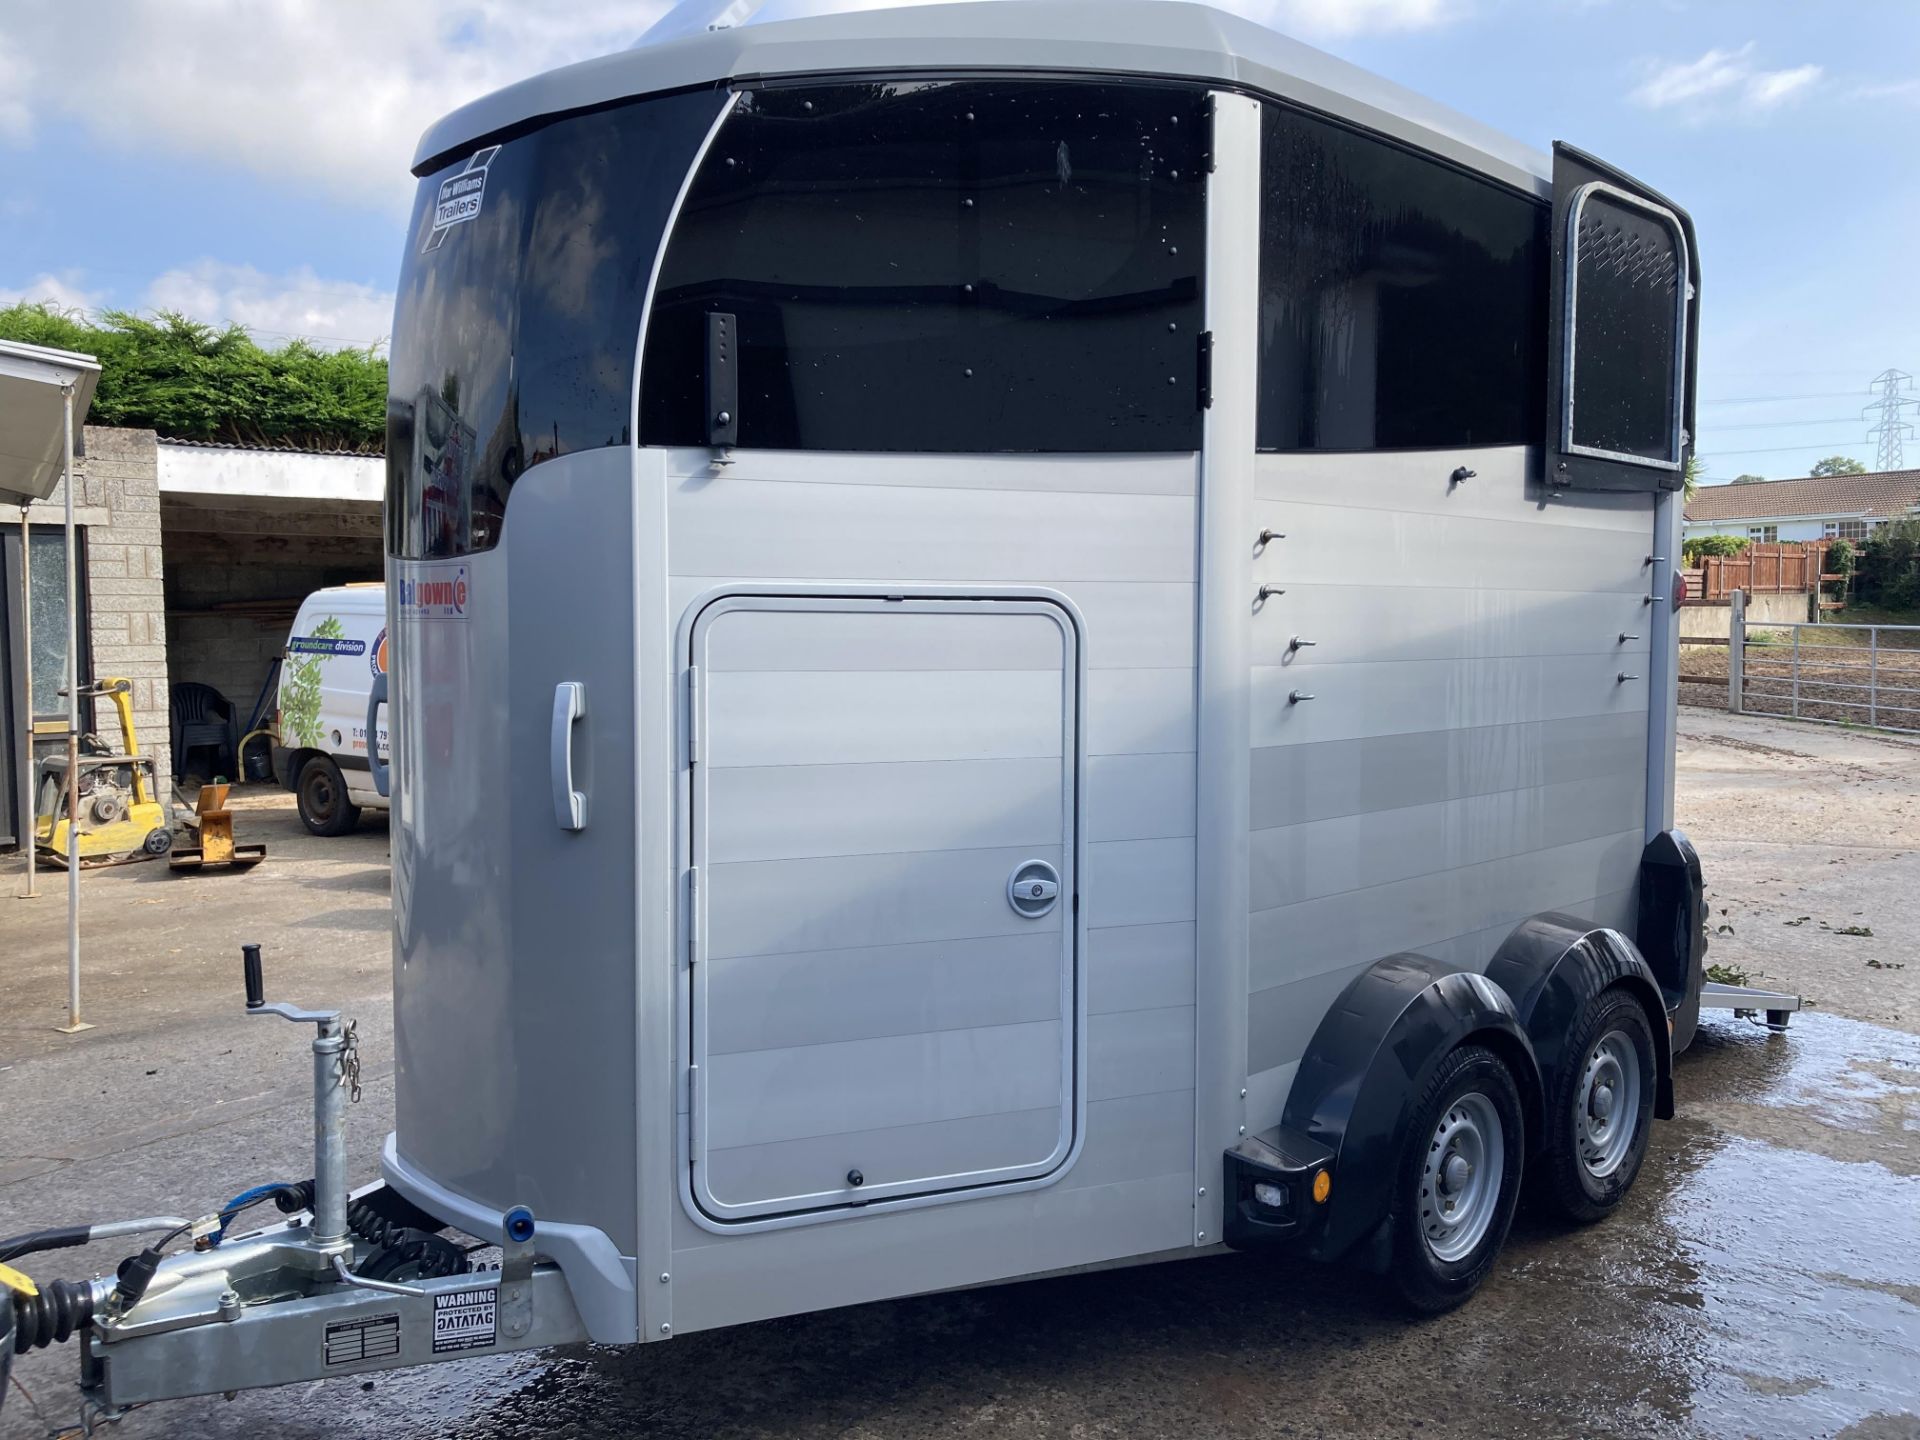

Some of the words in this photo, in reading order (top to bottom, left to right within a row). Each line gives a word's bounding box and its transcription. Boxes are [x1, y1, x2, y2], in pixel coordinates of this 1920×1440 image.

[452, 176, 483, 196] Williams
[439, 198, 478, 221] Trailers
[291, 639, 333, 652] groundcare
[335, 640, 364, 653] division
[436, 1289, 495, 1308] WARNING
[437, 1306, 482, 1317] PROTECTED
[437, 1312, 493, 1330] DATATAG
